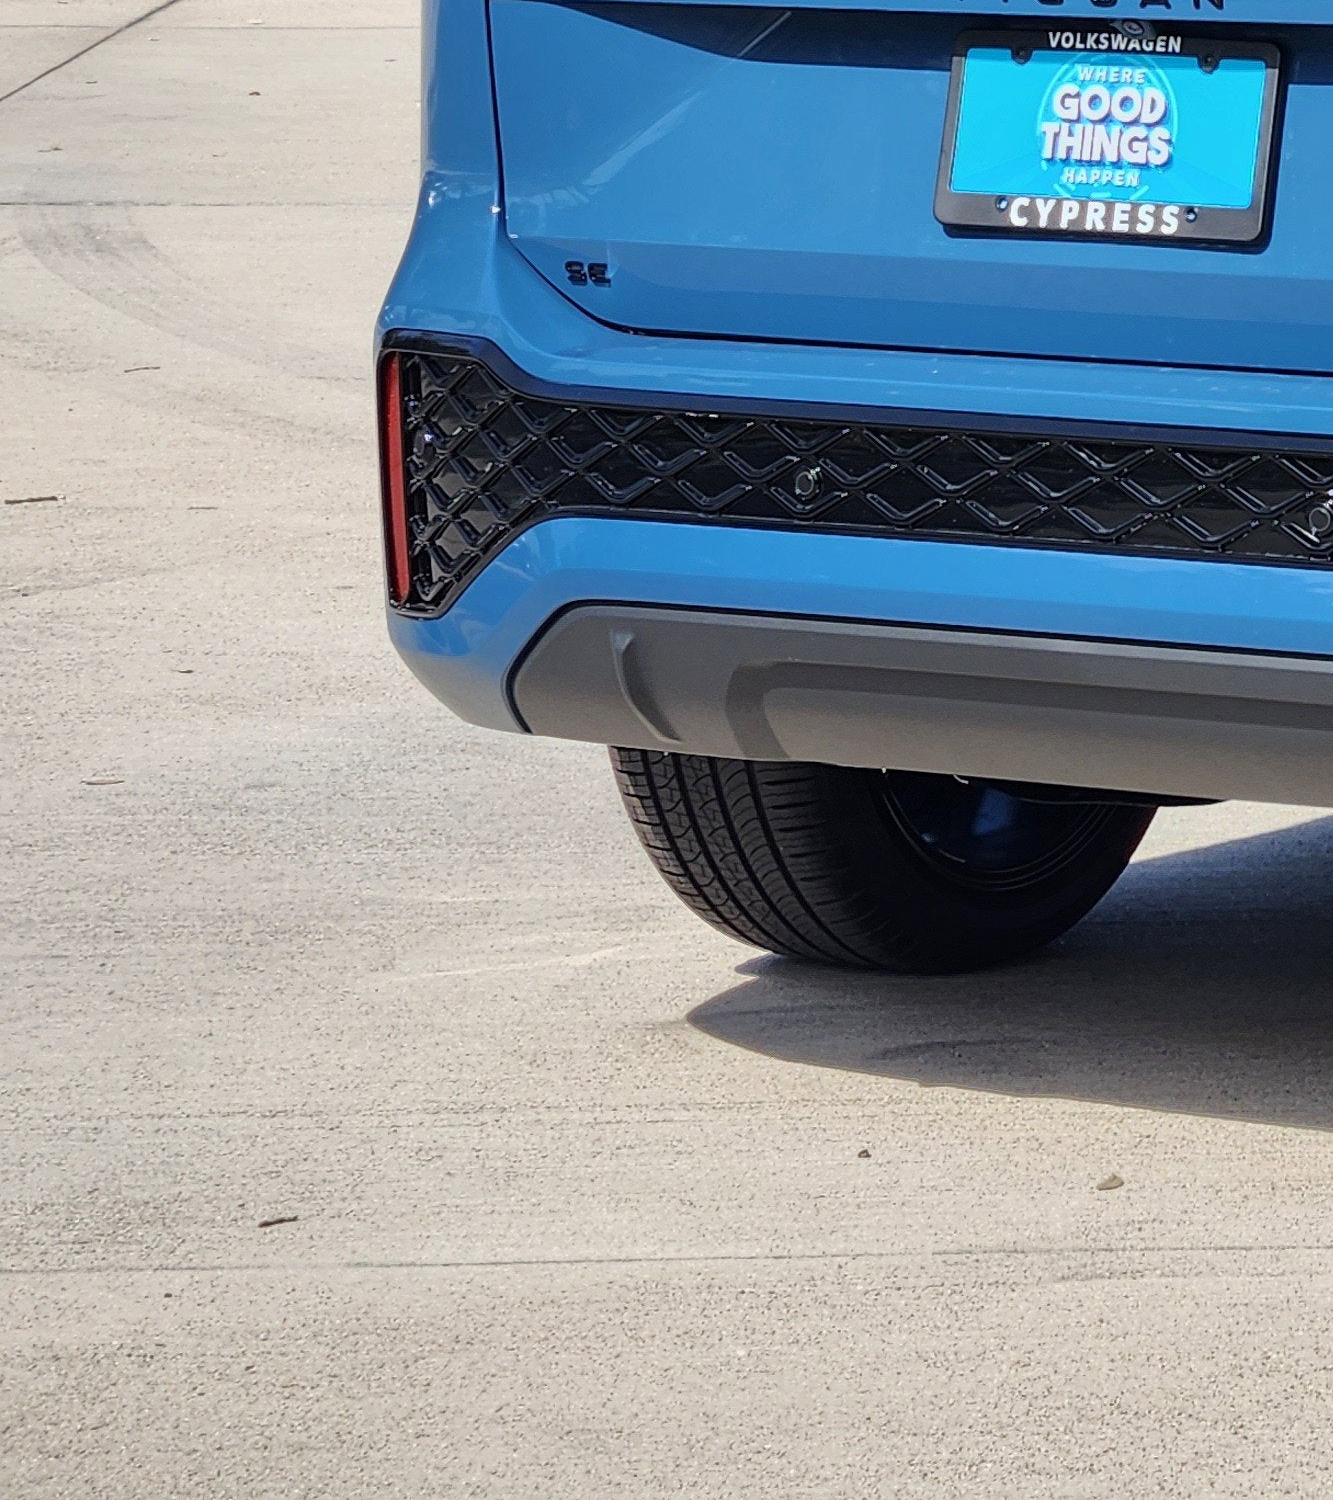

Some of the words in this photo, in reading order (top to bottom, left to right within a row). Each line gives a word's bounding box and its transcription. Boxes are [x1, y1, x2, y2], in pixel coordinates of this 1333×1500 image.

[1048, 31, 1182, 53] VOLKSWAGEN
[1077, 66, 1146, 84] WHERE
[1053, 85, 1167, 124] GOOD
[1042, 124, 1170, 166] THINGS
[1064, 167, 1140, 187] HAPPEN
[1008, 197, 1181, 235] CYPRESS
[565, 261, 611, 286] SE
